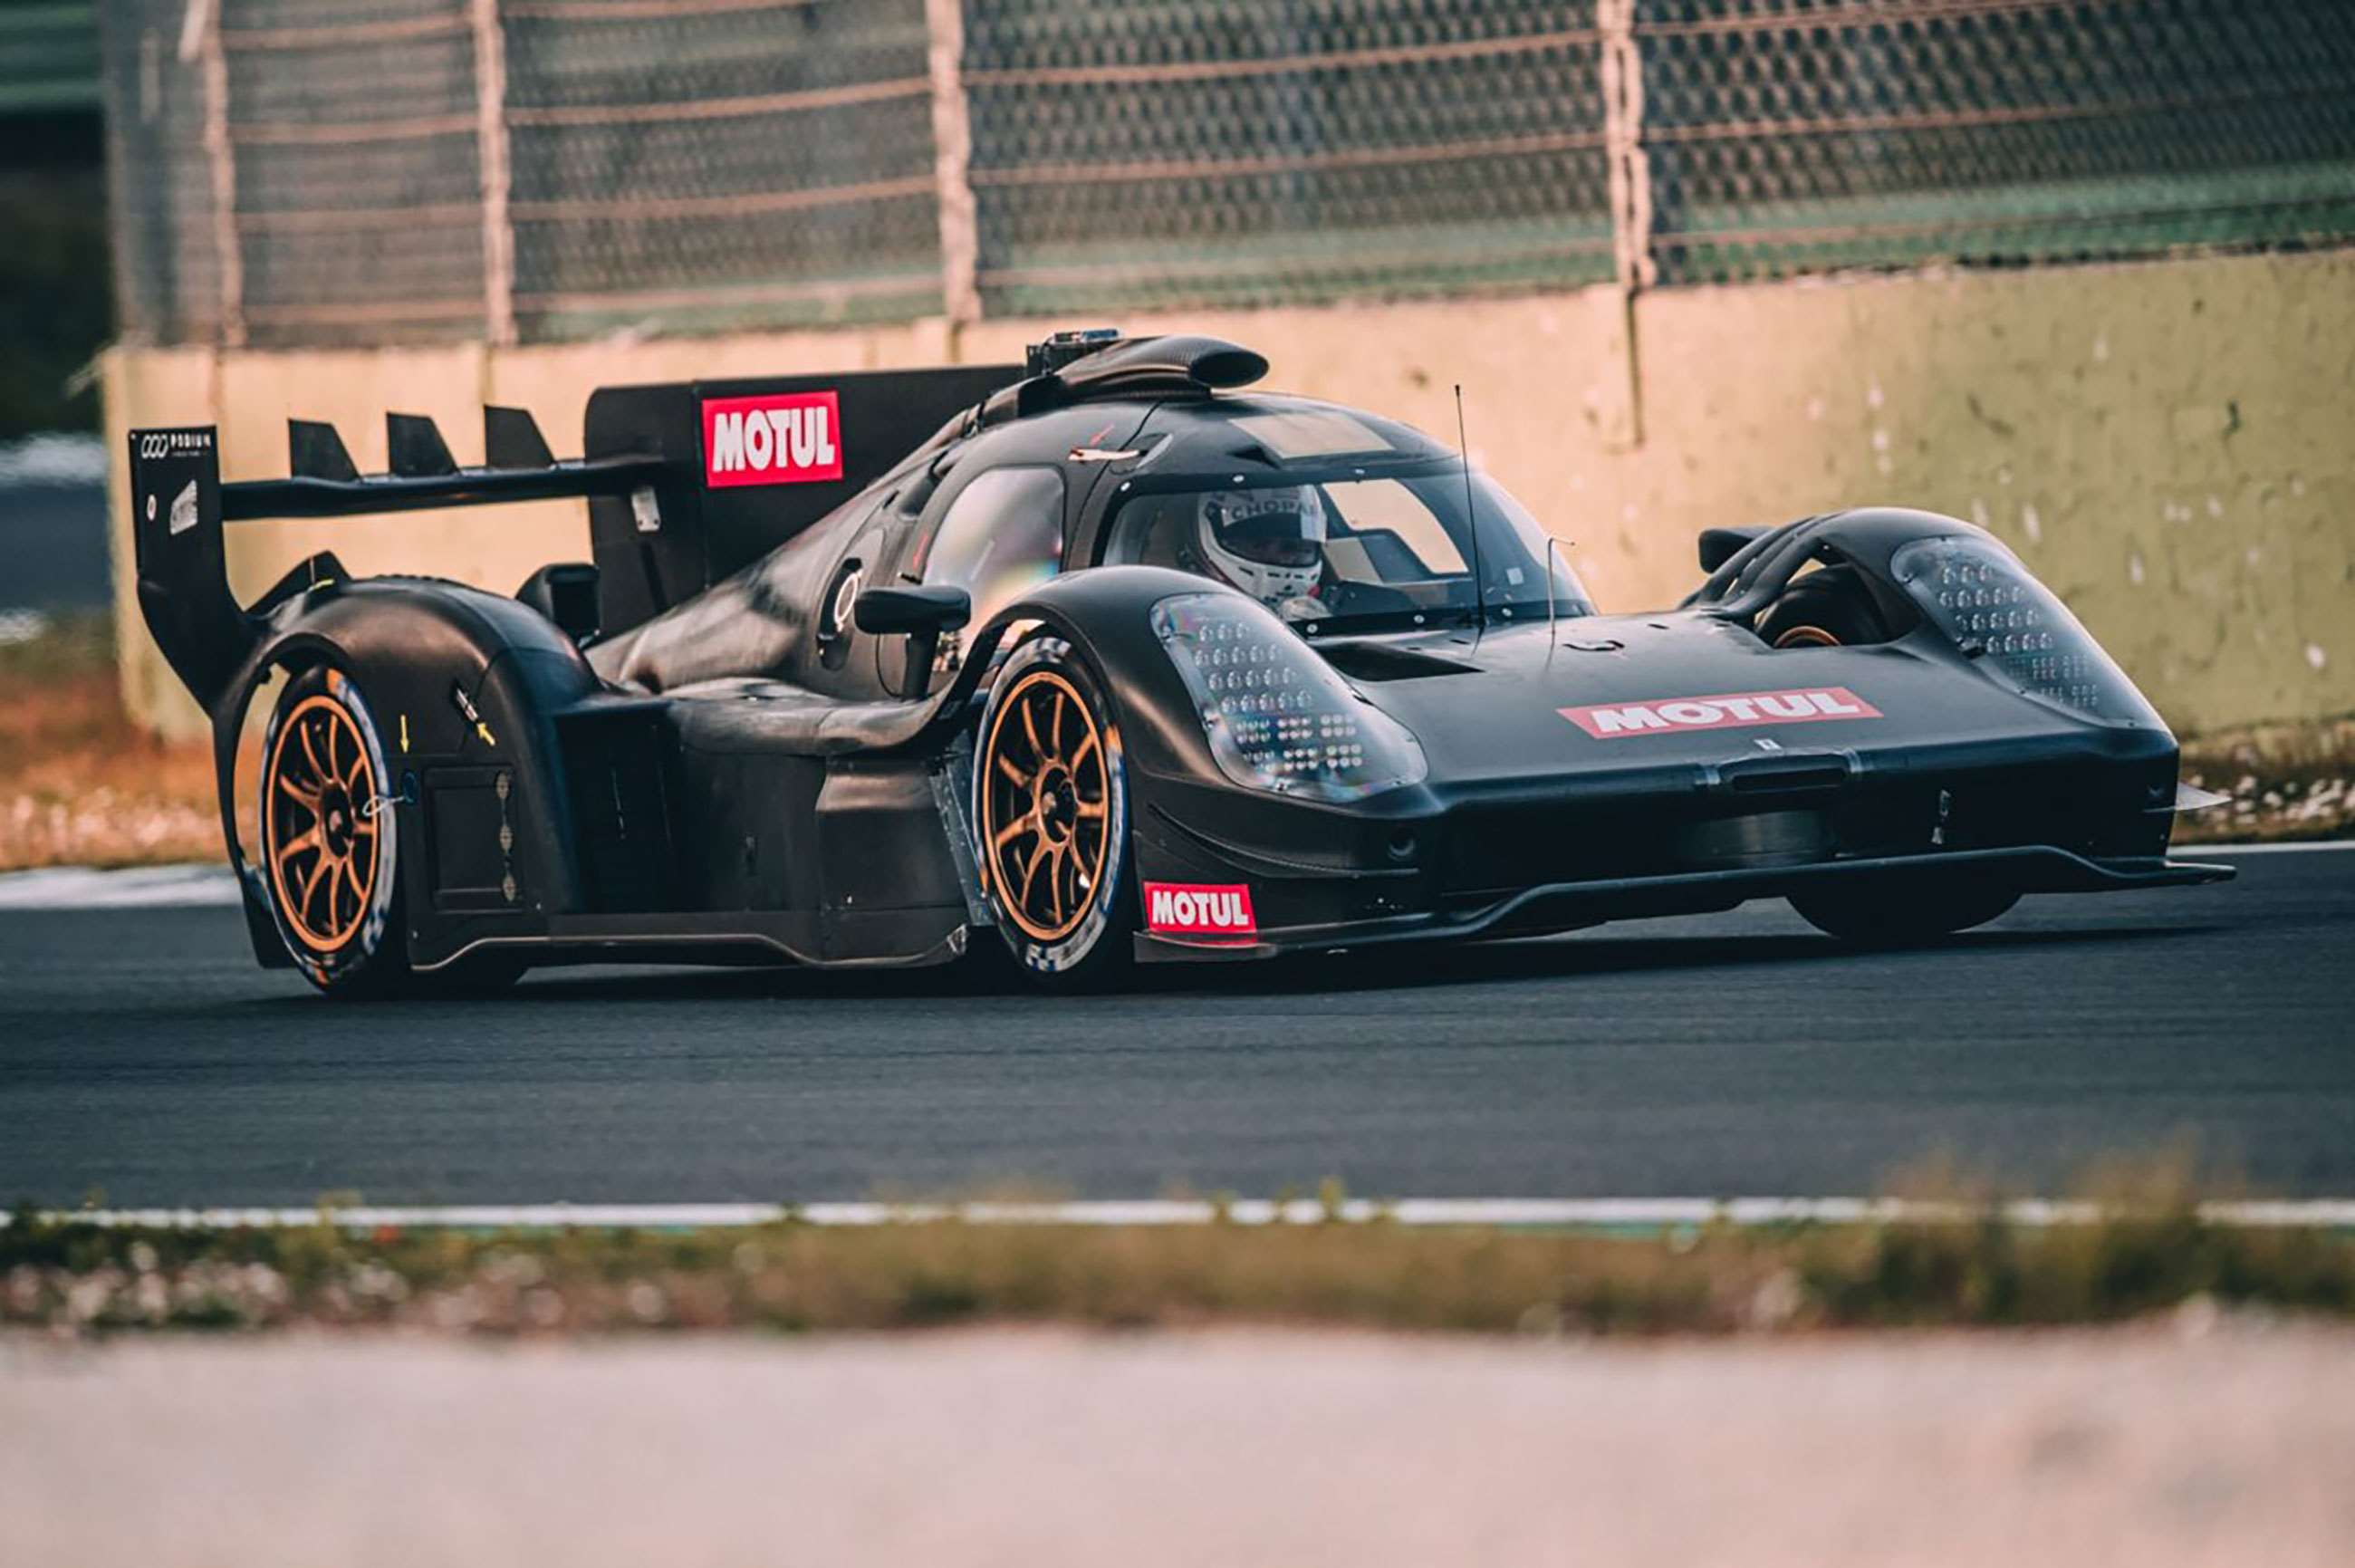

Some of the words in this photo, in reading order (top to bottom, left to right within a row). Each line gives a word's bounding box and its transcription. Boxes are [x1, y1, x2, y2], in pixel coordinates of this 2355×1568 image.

[713, 406, 835, 472] MOTUL
[1590, 693, 1860, 733] MOTUL
[1151, 890, 1249, 927] MOTUL
